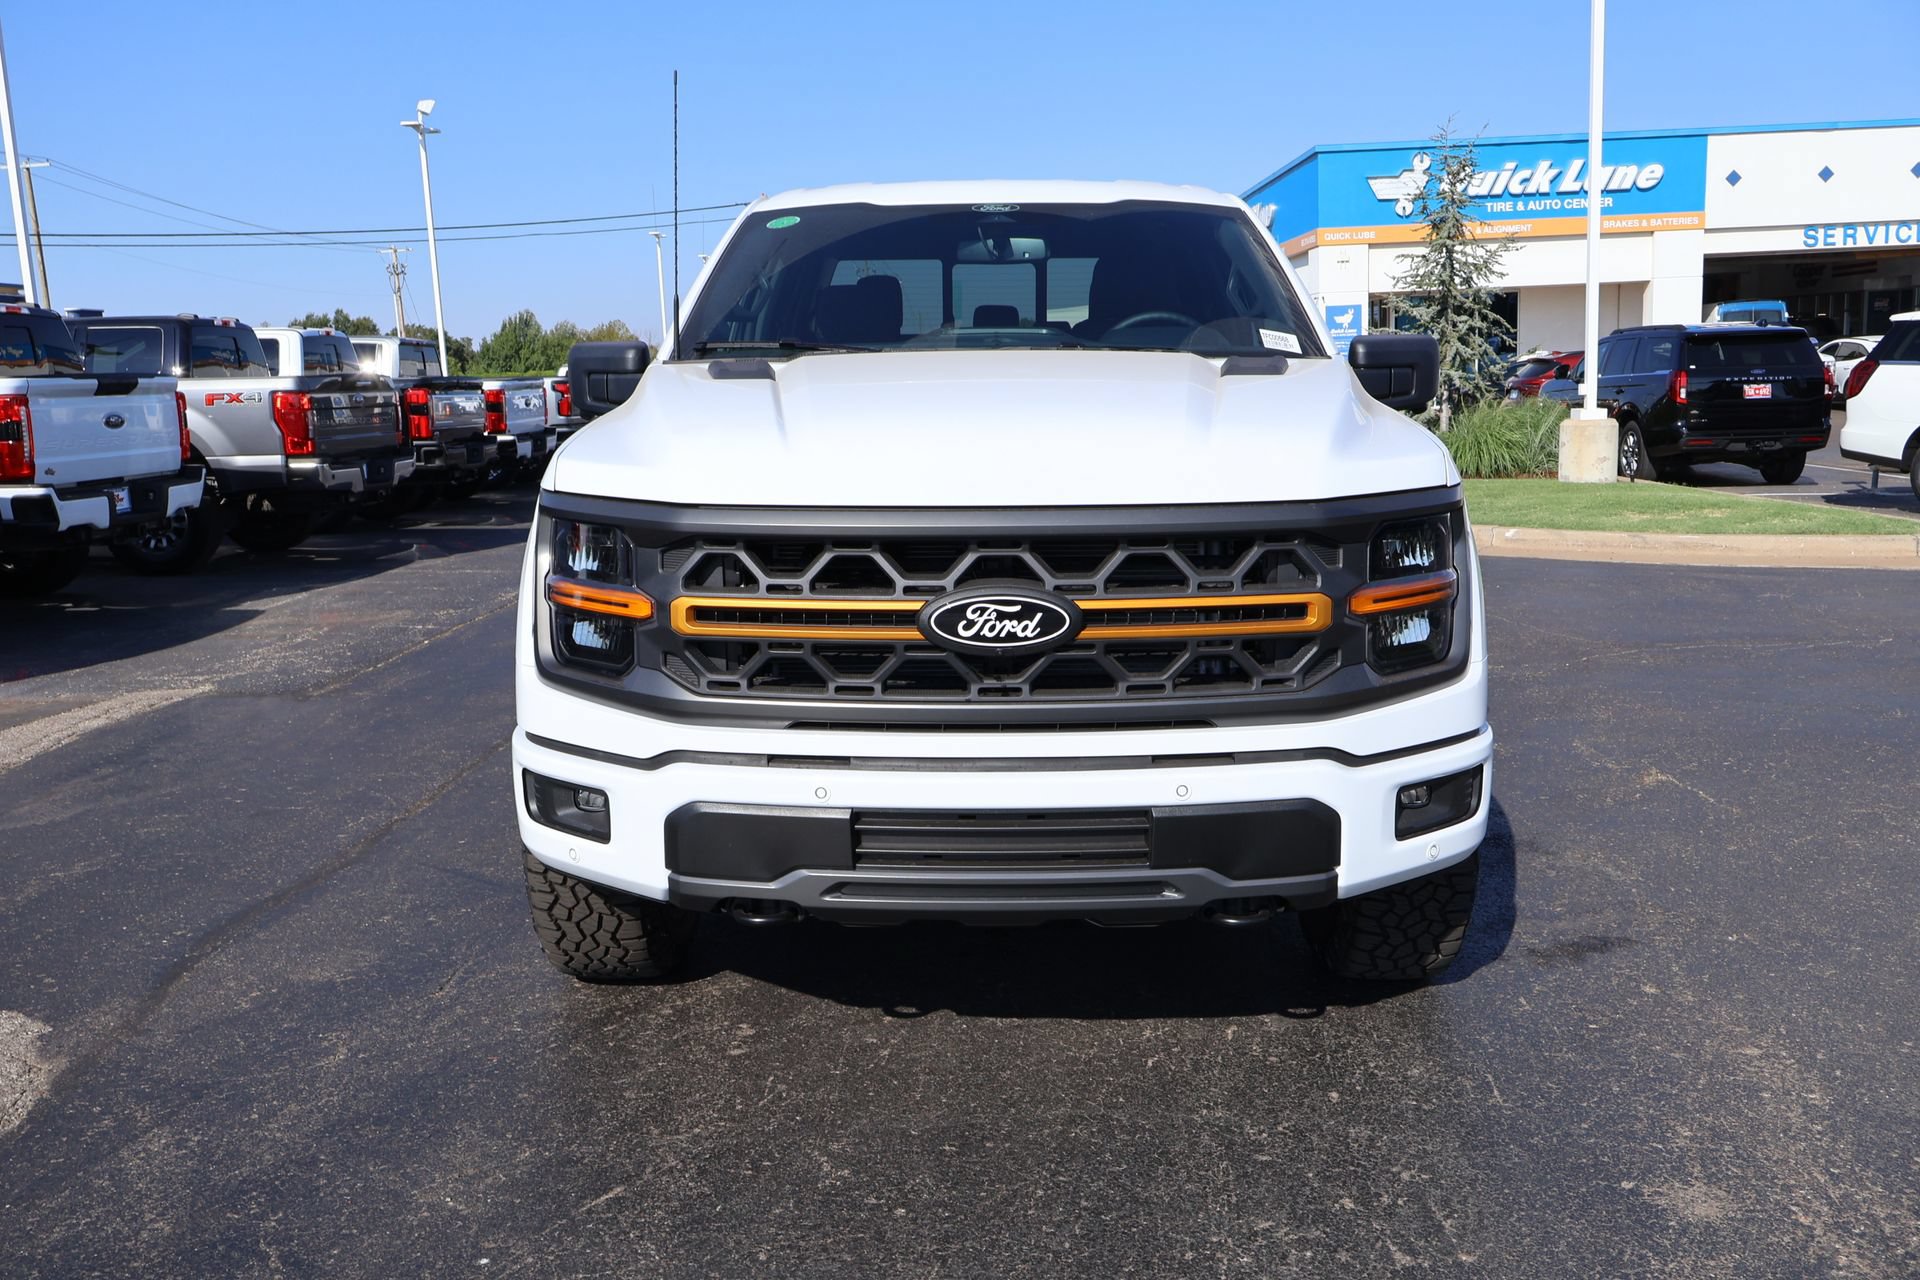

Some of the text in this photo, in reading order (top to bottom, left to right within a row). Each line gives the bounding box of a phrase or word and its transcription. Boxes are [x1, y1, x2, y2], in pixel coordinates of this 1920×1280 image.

[1555, 158, 1664, 193] Lne
[1485, 197, 1613, 212] TIRE & AUTO CENER
[1484, 224, 1533, 234] ALIGNMENT
[1603, 215, 1699, 229] BRAKES & BATTERIES
[1324, 232, 1351, 241] QUICK
[1353, 231, 1376, 239] LUBE
[204, 391, 263, 408] FX4
[957, 603, 1044, 638] Ford
